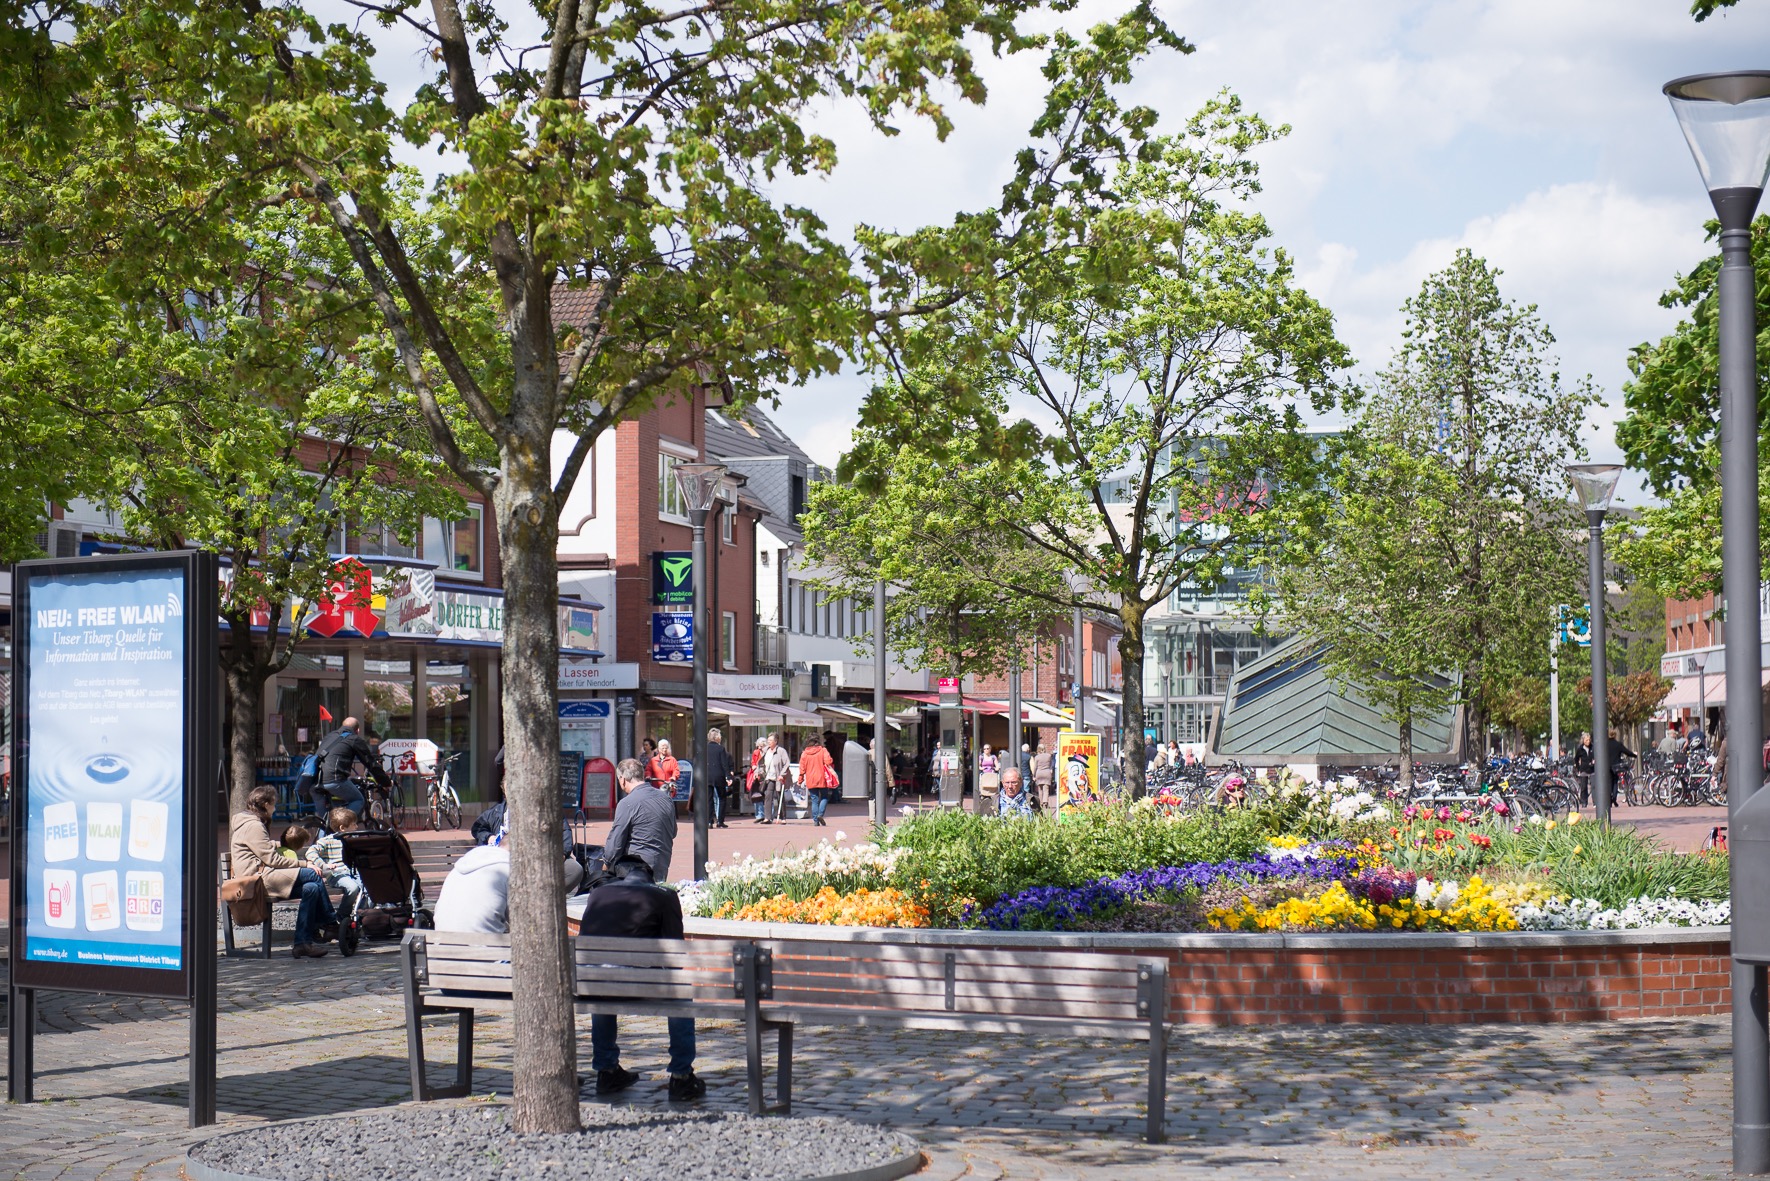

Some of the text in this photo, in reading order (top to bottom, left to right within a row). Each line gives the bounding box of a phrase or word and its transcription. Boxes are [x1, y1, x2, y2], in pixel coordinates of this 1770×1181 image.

[37, 604, 165, 628] NEU: FREE WLAN
[53, 627, 163, 647] Unser Tibarg: Quelle für
[46, 646, 172, 667] Information und Inspiration
[564, 668, 599, 677] Lassen
[576, 679, 585, 687] für
[587, 679, 617, 687] Niendorf.
[739, 682, 755, 691] Optik
[1062, 745, 1096, 756] FRANK
[46, 822, 121, 841] FREE WLAN
[78, 951, 103, 960] Business
[103, 953, 138, 962] Improvement
[140, 955, 161, 964] District
[161, 957, 180, 966] Tibarg
